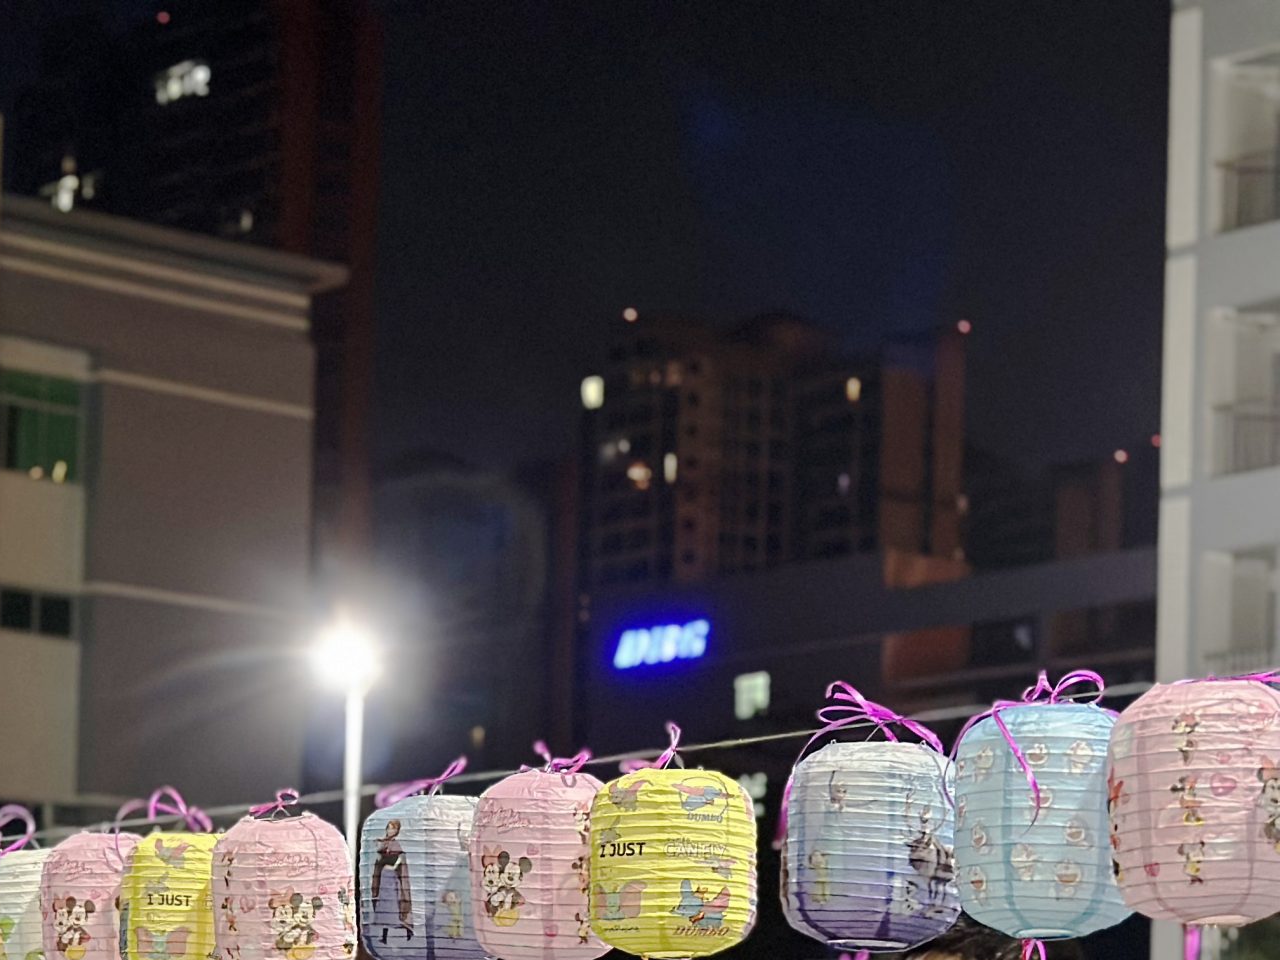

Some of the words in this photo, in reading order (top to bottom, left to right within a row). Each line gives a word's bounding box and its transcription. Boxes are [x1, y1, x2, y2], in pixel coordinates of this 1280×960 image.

[600, 844, 607, 858] I
[609, 842, 646, 857] JUST
[147, 894, 154, 905] I
[158, 894, 192, 907] JUST
